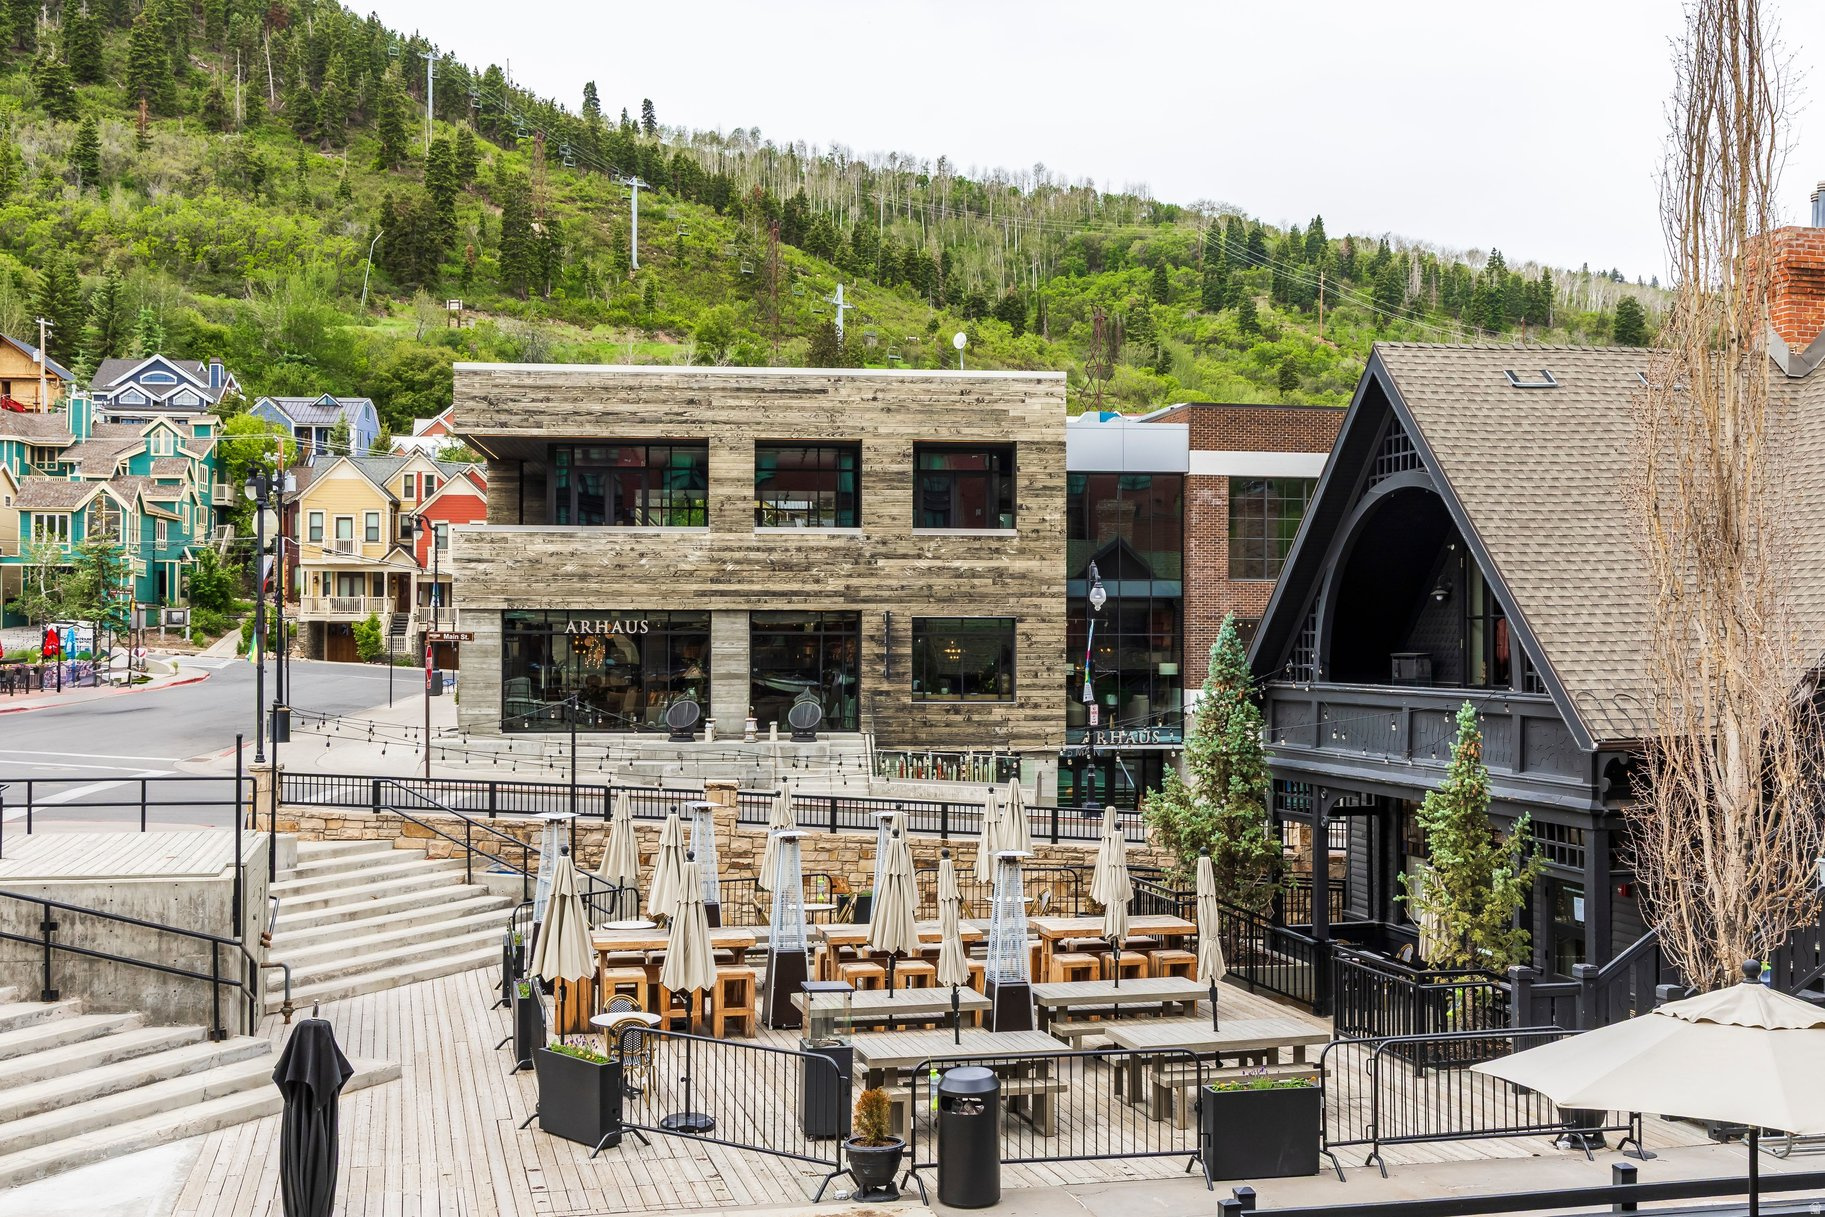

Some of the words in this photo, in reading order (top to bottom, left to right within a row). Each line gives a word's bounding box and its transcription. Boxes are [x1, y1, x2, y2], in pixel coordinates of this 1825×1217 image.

[564, 619, 649, 634] ARHAUS
[1081, 730, 1160, 745] ARHAUS
[1075, 748, 1101, 757] MAN
